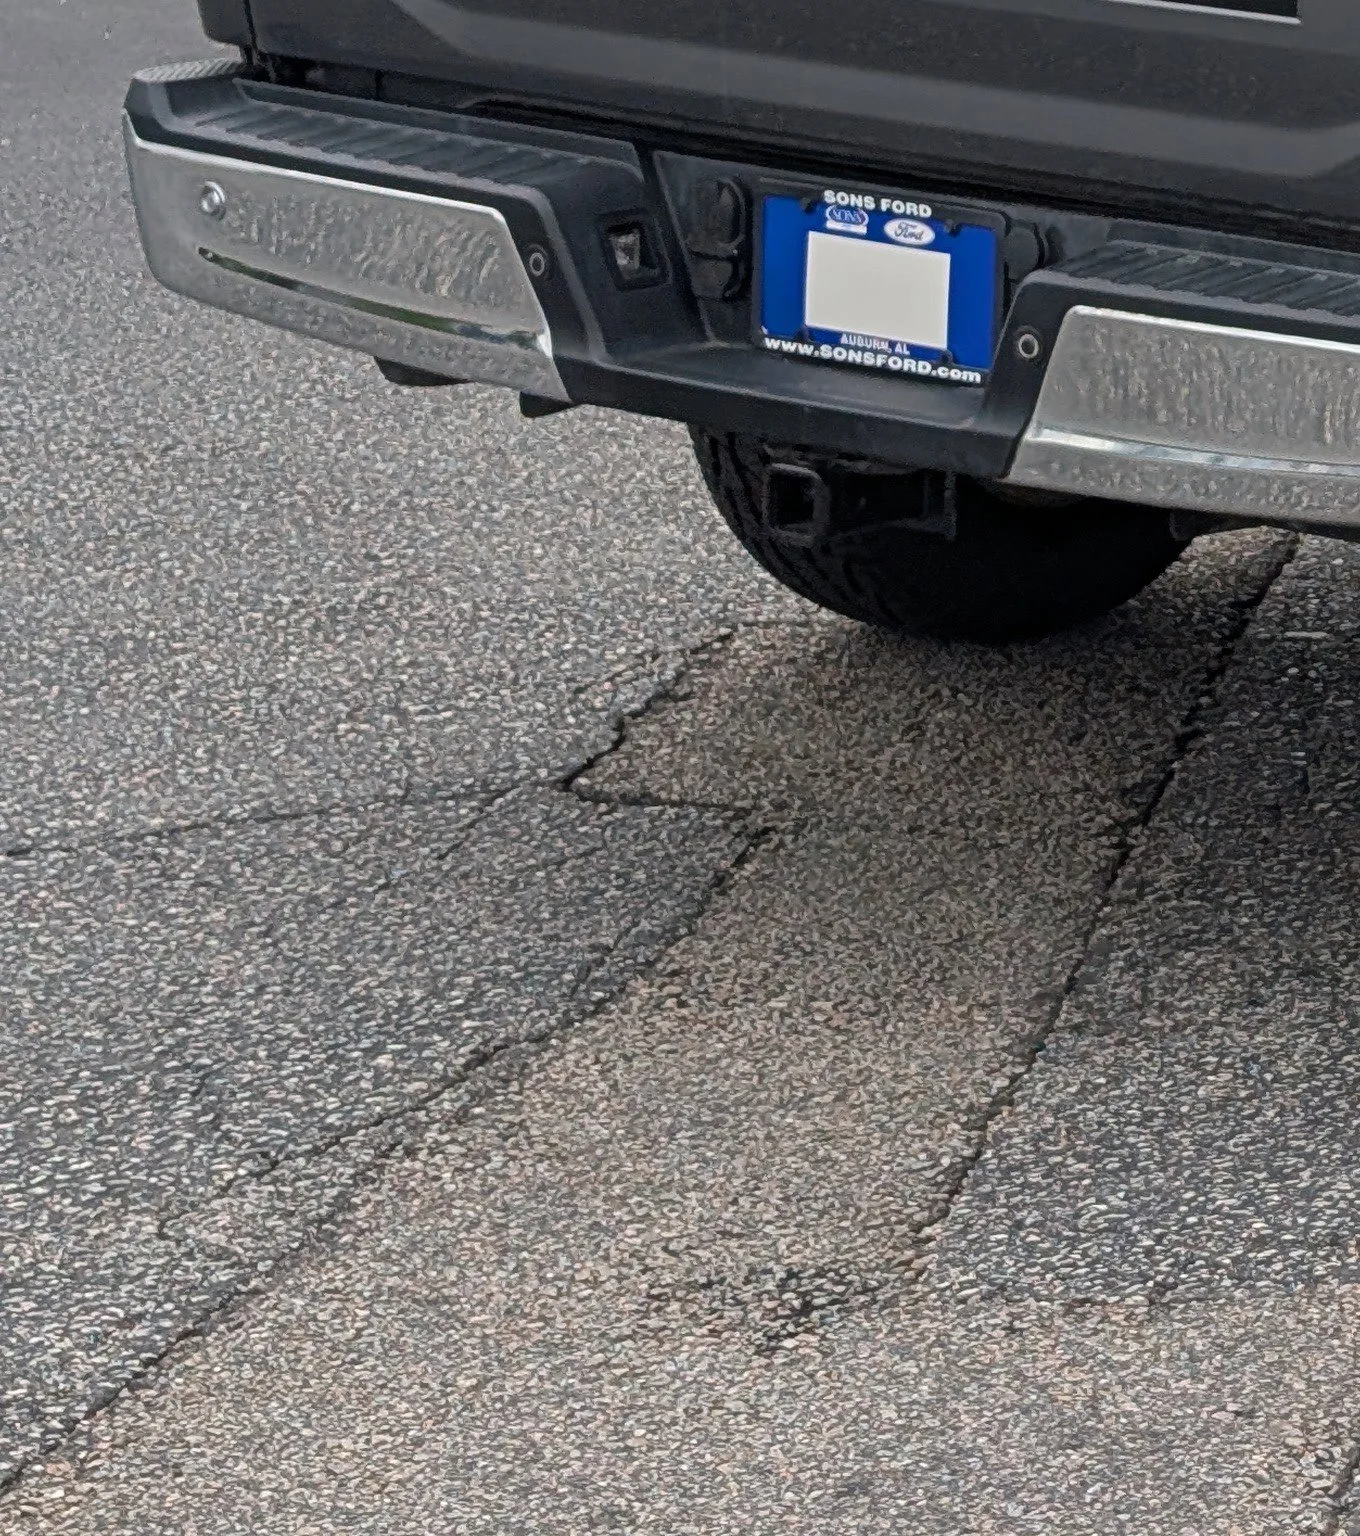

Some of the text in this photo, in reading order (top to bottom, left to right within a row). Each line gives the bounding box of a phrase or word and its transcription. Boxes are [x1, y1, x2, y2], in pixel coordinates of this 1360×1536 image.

[823, 189, 932, 218] SONS FORD
[763, 336, 982, 384] www.SONSFORD.com
